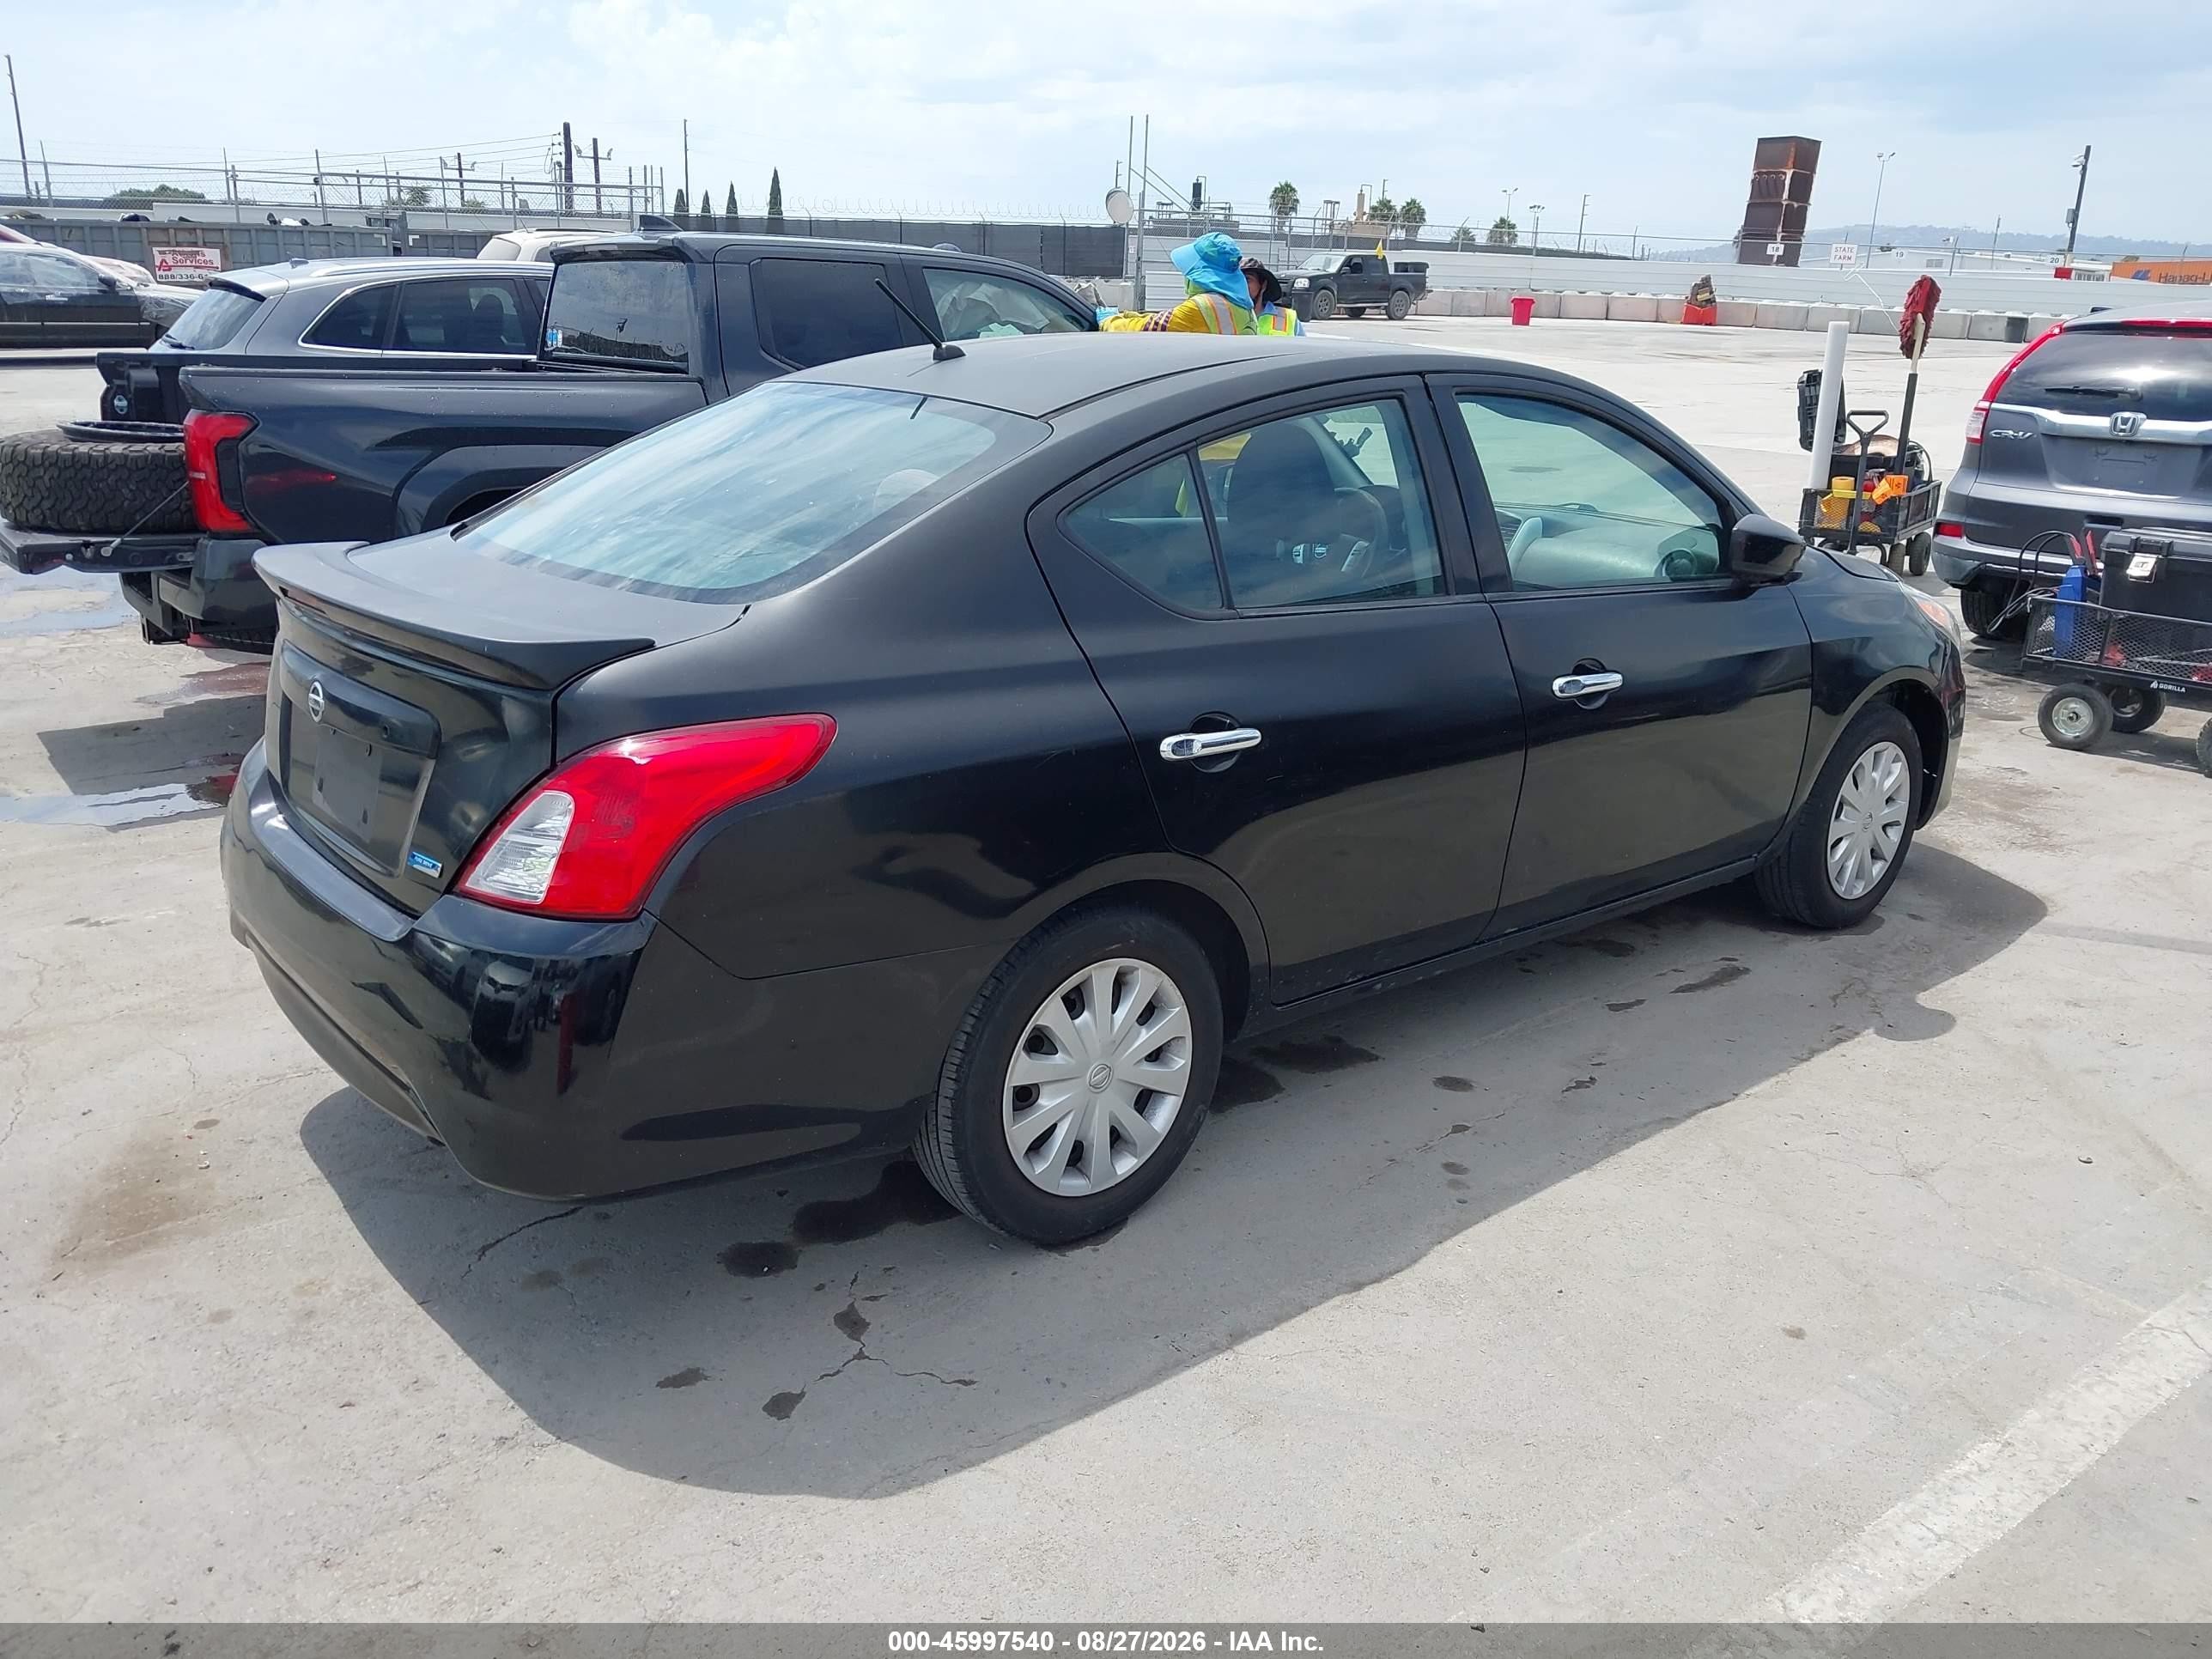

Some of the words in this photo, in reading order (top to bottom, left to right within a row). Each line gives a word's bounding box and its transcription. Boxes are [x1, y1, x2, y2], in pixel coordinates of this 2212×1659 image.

[172, 256, 214, 265] Services
[1989, 429, 2035, 440] CR-V
[2159, 683, 2186, 693] GORILLA
